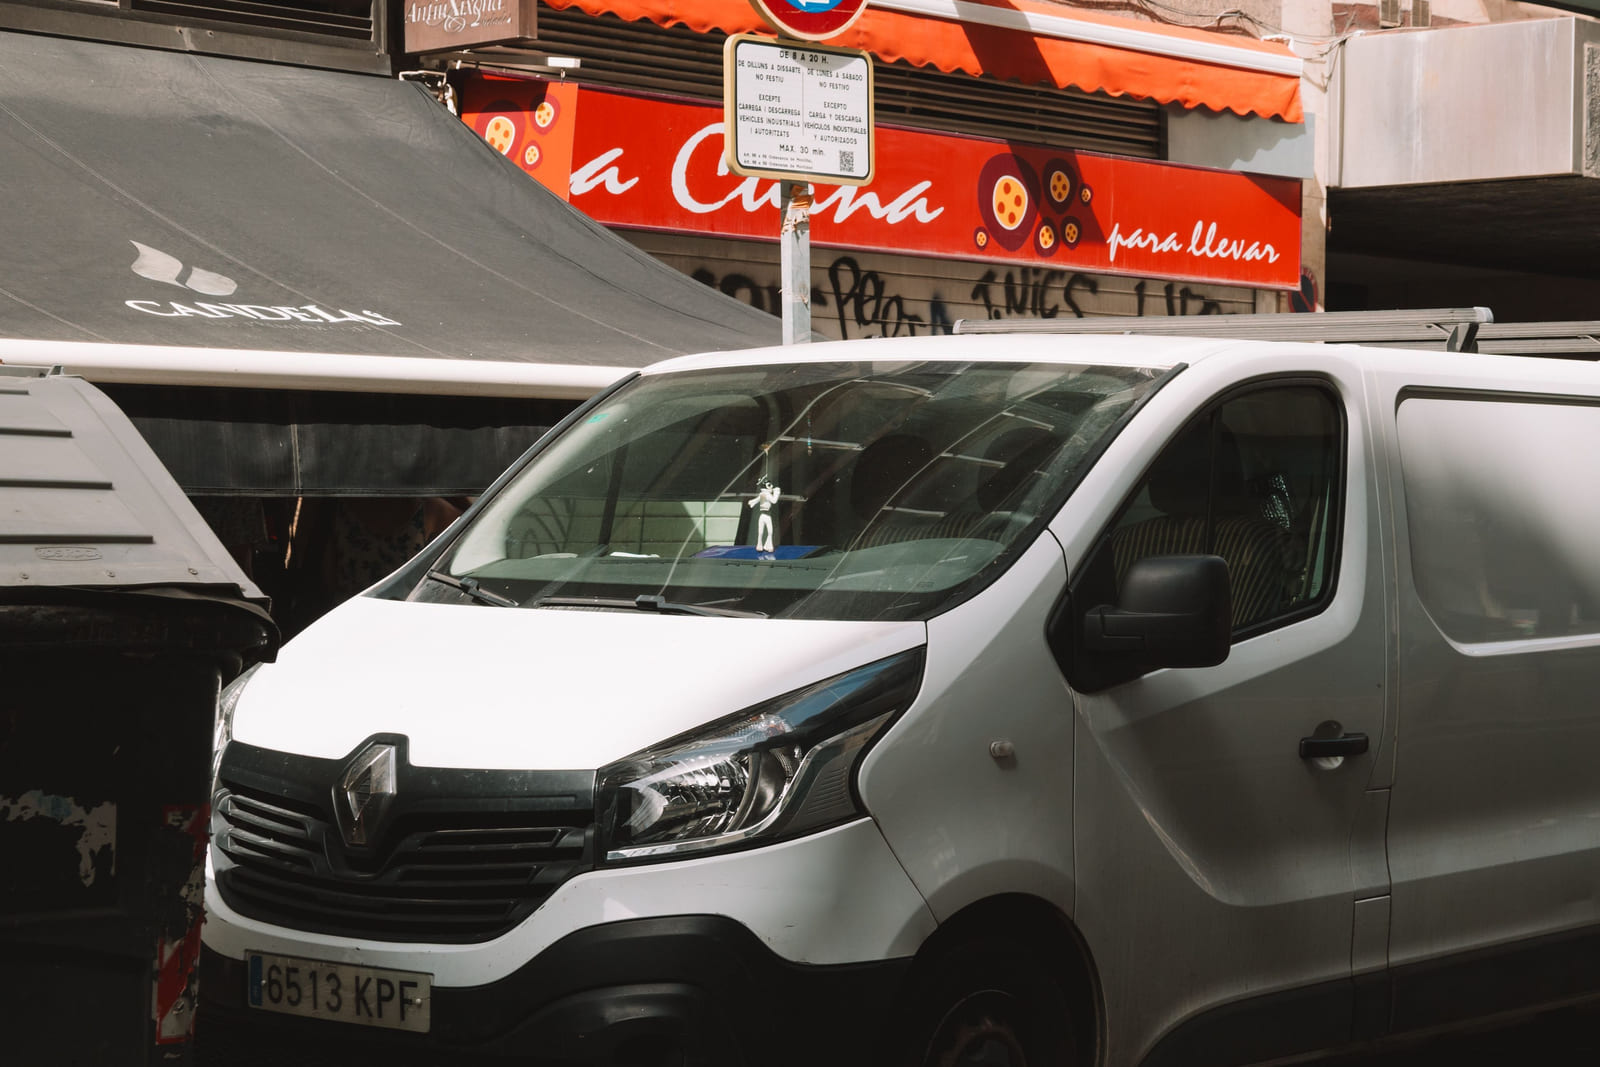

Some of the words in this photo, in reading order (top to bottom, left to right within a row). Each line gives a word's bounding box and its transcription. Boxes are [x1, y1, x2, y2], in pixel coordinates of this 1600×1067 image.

[780, 51, 789, 59] DE
[792, 52, 797, 60] 8
[801, 53, 806, 61] A
[809, 54, 818, 63] 20
[747, 61, 768, 70] DILLUNS
[777, 65, 801, 74] DISSABTE
[807, 68, 814, 76] DE
[816, 69, 833, 78] LUNES
[766, 75, 784, 83] FESTIU
[829, 82, 850, 91] FESTIVO
[759, 94, 781, 103] EXCEPTE
[824, 101, 847, 110] EXCEPTO
[739, 115, 764, 124] VEHICLES
[766, 118, 800, 128] INDUSTRIALS
[808, 111, 826, 119] CARGA
[834, 114, 862, 123] DESCARGA
[754, 128, 790, 138] AUTORITZATS
[833, 124, 867, 135] INDUSTRIALES
[820, 135, 858, 145] AUTORIZADOS
[800, 146, 809, 154] 30
[1106, 223, 1183, 263] para
[1187, 219, 1280, 264] llevar
[124, 300, 402, 327] CANDELAS
[267, 964, 343, 1013] 6513
[354, 975, 419, 1022] KPF
